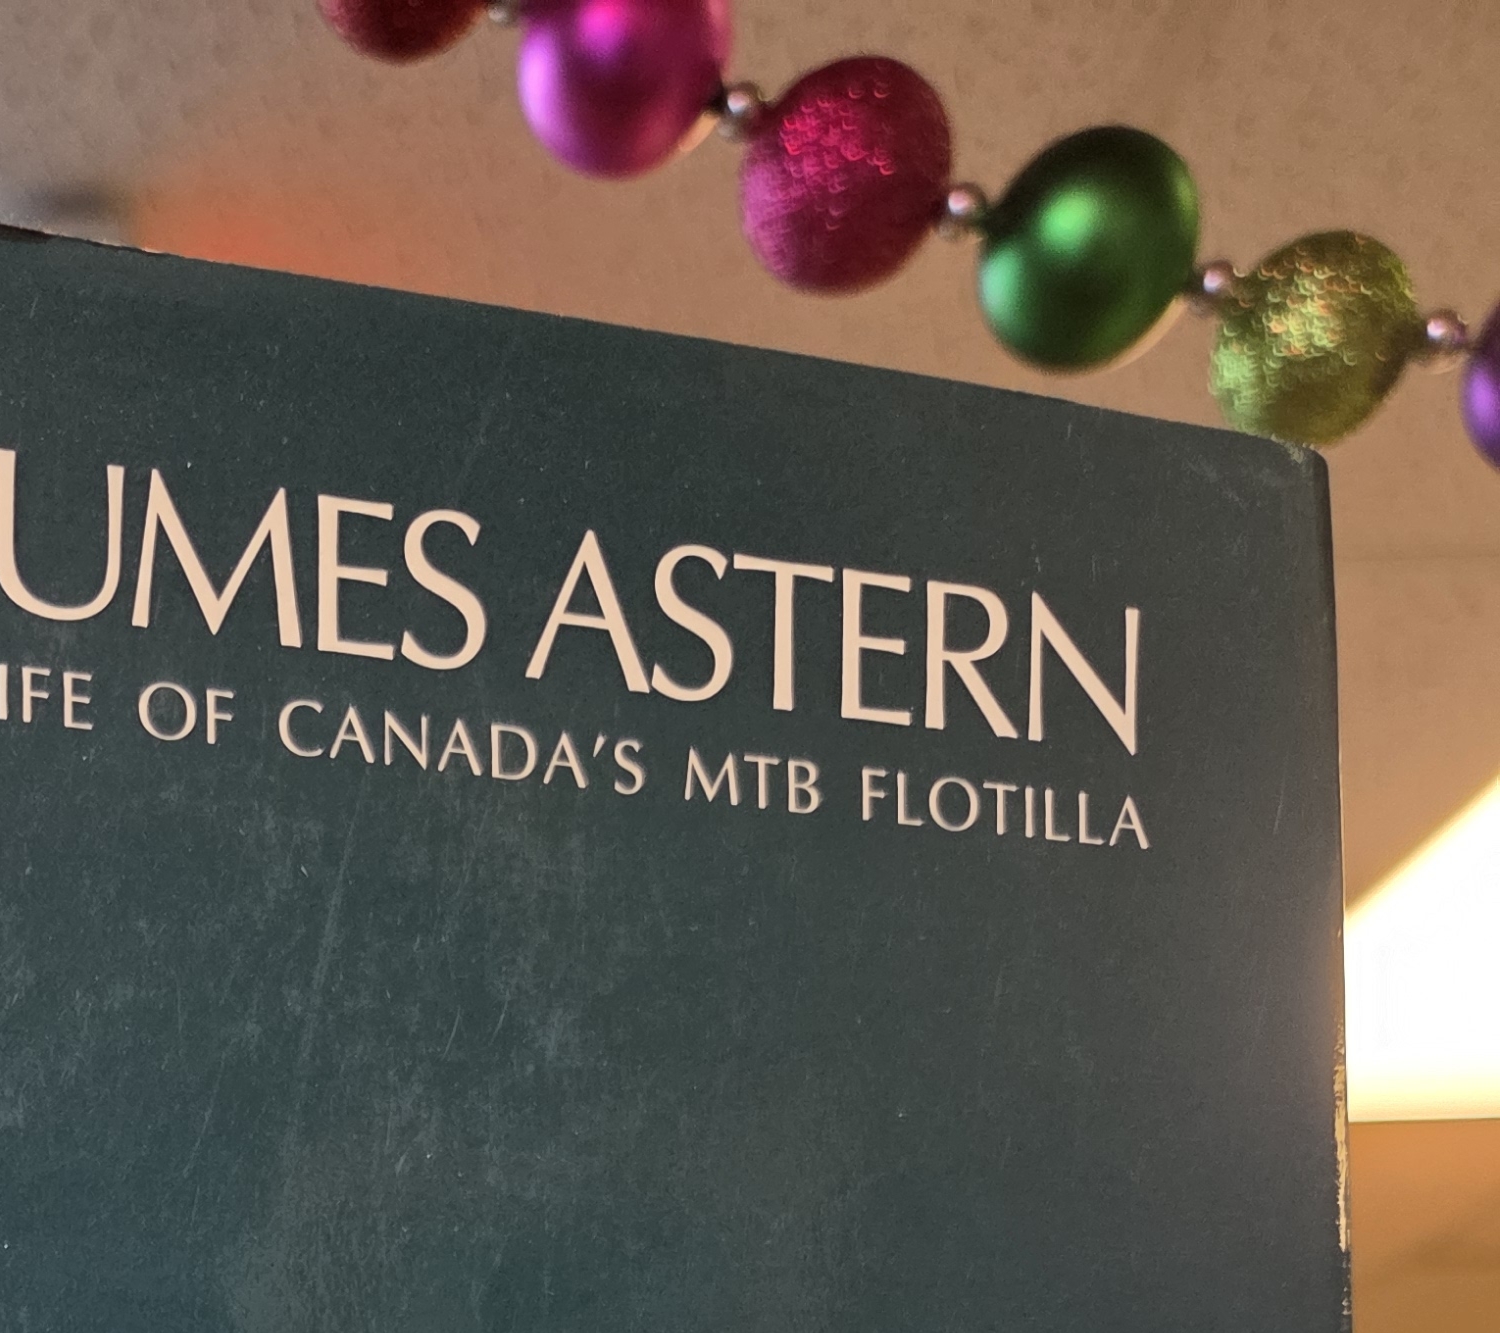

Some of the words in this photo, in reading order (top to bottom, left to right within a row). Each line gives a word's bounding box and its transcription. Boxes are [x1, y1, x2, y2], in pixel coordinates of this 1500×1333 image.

[524, 528, 1141, 757] ASTERN
[137, 681, 235, 746] OF
[277, 699, 645, 798] CANADA'S
[683, 746, 821, 815] MTB
[860, 766, 1150, 851] FLOTILLA
